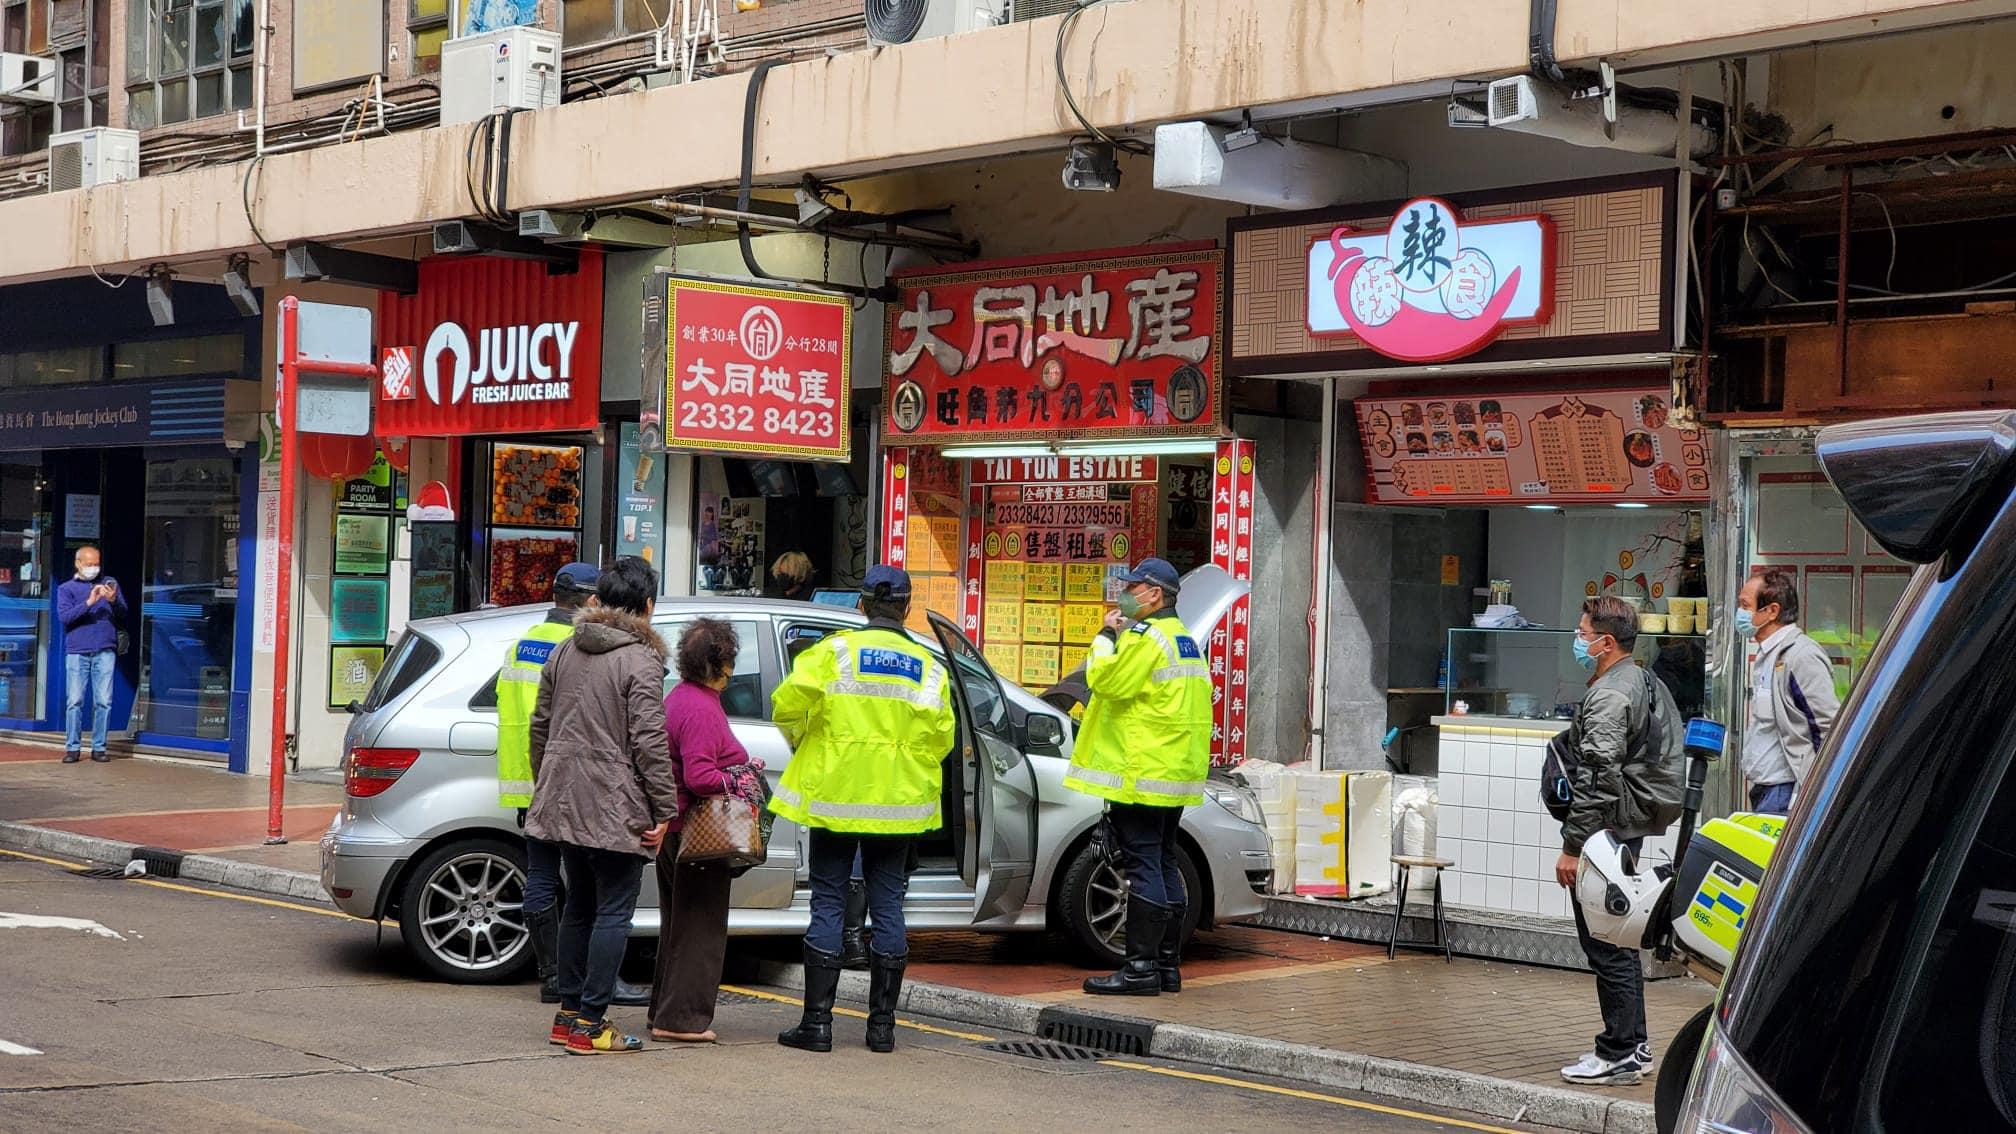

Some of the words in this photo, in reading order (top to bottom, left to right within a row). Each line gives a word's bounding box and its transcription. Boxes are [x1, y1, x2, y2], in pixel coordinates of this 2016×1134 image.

[1393, 203, 1452, 285] 辣
[471, 321, 579, 384] JUICY
[472, 385, 507, 403] FRESH
[509, 383, 543, 401] JUICE
[544, 382, 570, 399] BAR
[0, 410, 35, 429] 賽馬會
[41, 411, 55, 427] The
[56, 408, 74, 430] Hong
[75, 409, 94, 429] Kong
[93, 407, 118, 428] Jockey
[119, 405, 138, 423] Club
[680, 401, 755, 432] 2332
[763, 407, 834, 437] 8423
[983, 458, 1012, 481] TAI
[1021, 457, 1059, 480] TUN
[1068, 456, 1143, 479] ESTATE
[350, 484, 376, 493] PARTY
[350, 493, 377, 502] ROOM
[999, 504, 1054, 525] 23328423
[1063, 504, 1122, 525] 23329556
[1025, 530, 1061, 558] 售盤
[1066, 532, 1107, 560] 租盤
[345, 658, 369, 685] 酒
[874, 656, 912, 671] POLICE
[1693, 909, 1711, 925] 695
